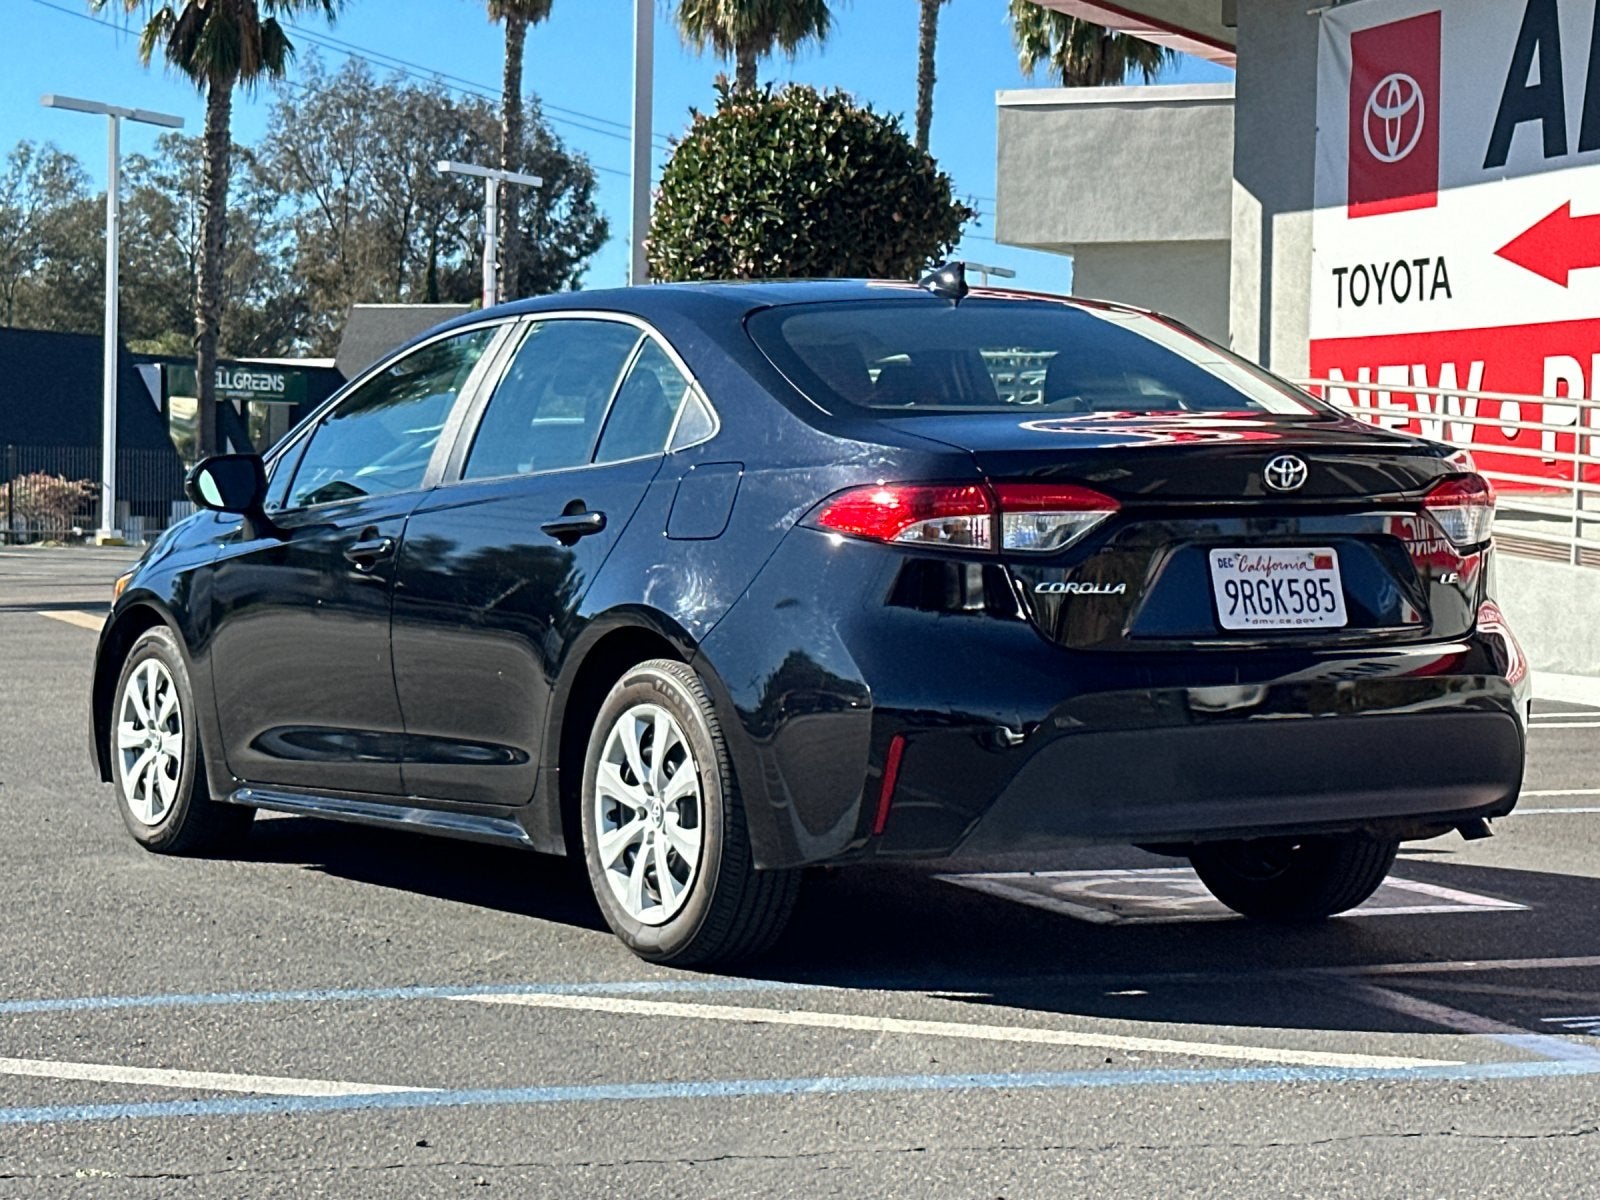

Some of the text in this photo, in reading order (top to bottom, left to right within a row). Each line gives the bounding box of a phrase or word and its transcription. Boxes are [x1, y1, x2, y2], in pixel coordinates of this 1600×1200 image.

[1332, 256, 1452, 308] TOYOTA
[195, 370, 285, 392] ELLGREENS
[1328, 361, 1485, 443] NEW
[1218, 555, 1317, 577] DEC California
[1034, 582, 1126, 594] COROLLA
[1441, 573, 1459, 584] LE
[1224, 578, 1336, 616] 9RGK585
